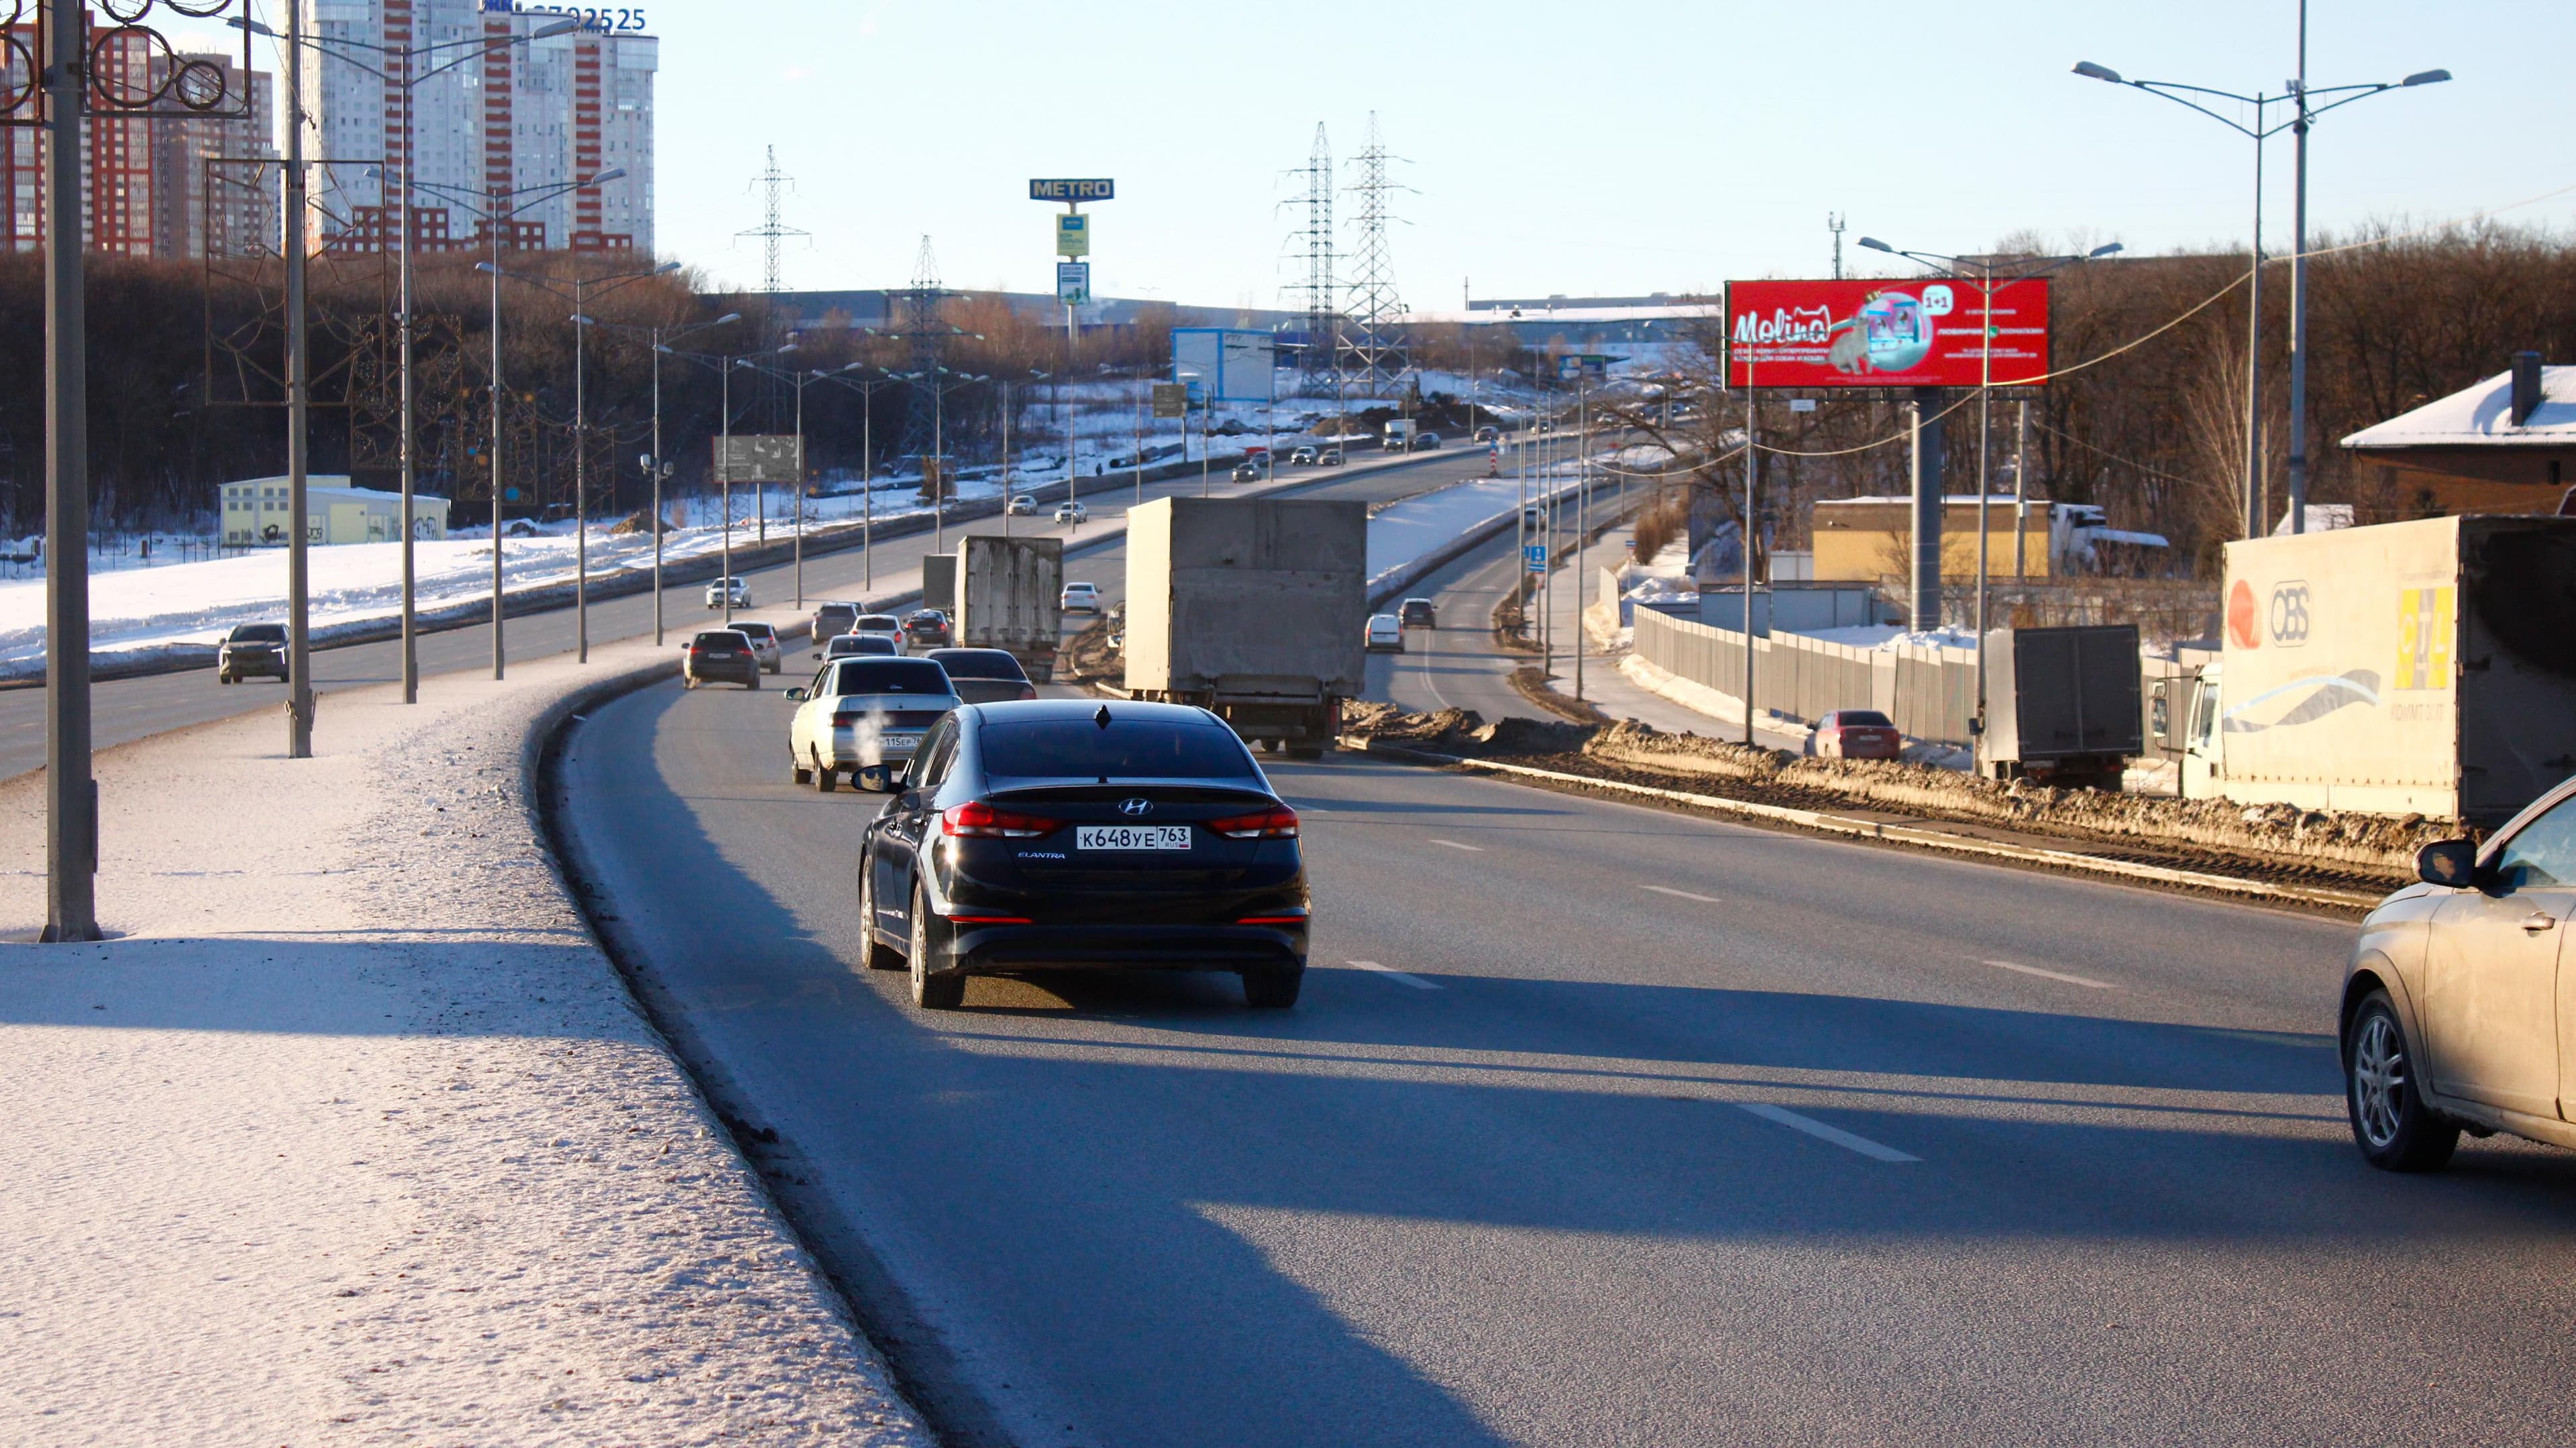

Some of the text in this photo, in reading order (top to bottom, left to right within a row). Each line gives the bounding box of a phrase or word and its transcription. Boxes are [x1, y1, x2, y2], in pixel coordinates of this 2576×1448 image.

[1034, 180, 1110, 196] METRO
[1925, 296, 1948, 308] 1+1
[1733, 304, 1831, 343] Molina
[2271, 586, 2310, 642] OBS
